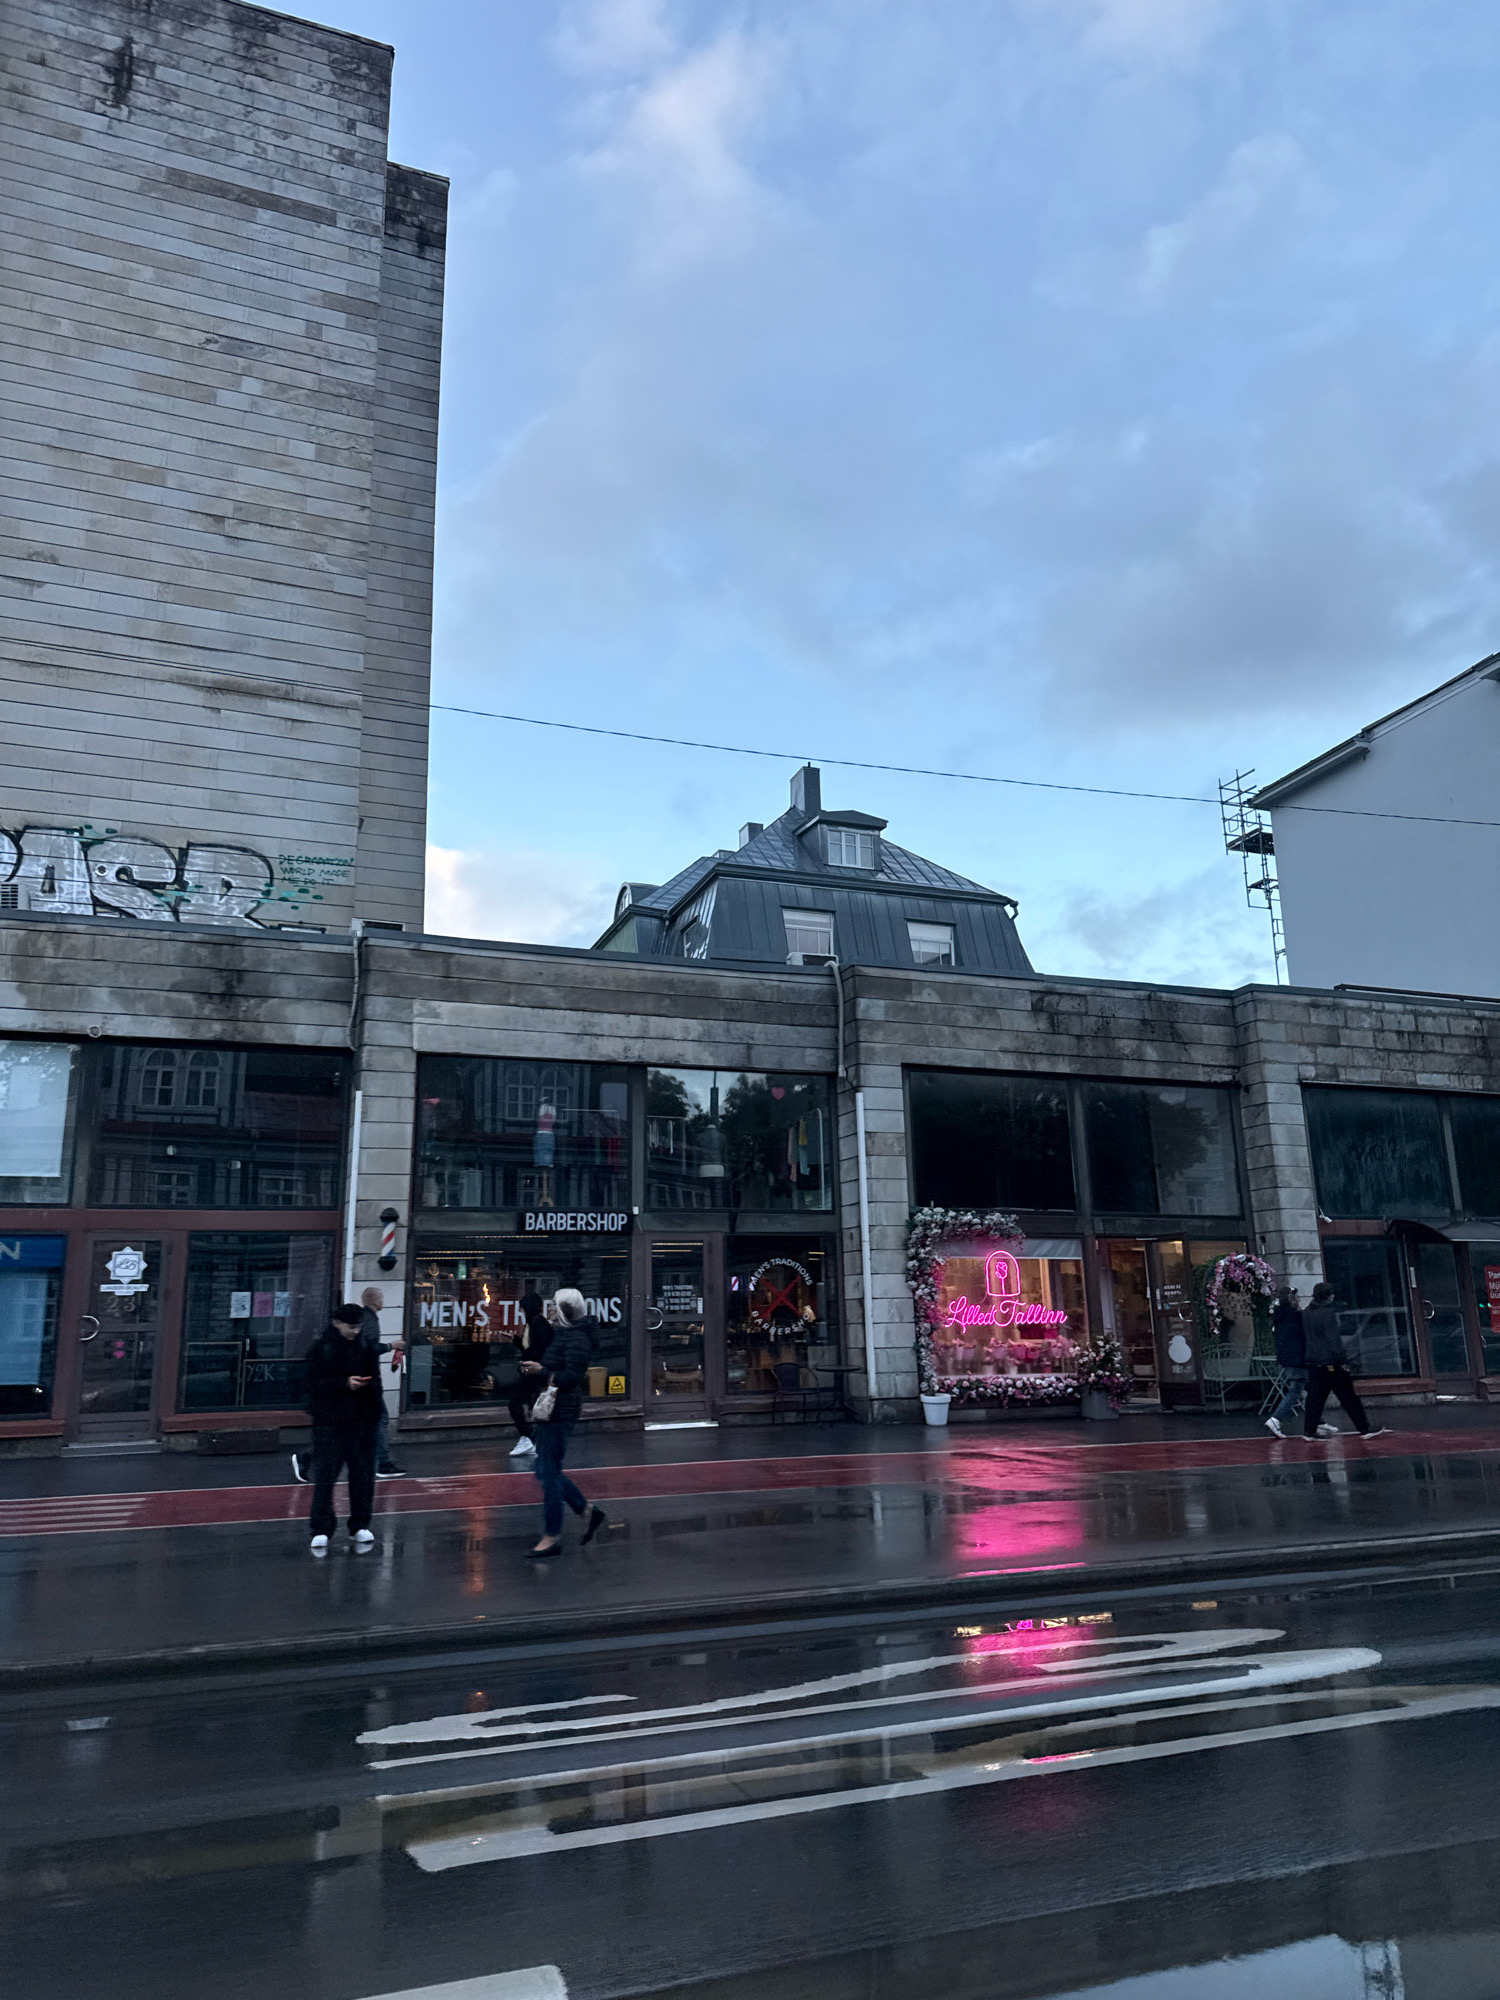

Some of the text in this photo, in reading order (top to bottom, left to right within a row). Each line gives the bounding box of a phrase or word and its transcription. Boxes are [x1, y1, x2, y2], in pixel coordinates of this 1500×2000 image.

[525, 1212, 628, 1232] BARBERSHOP
[769, 1257, 814, 1287] TRADITIONS
[420, 1300, 490, 1328] MEN'S
[944, 1295, 1069, 1334] Lilled Tallinn
